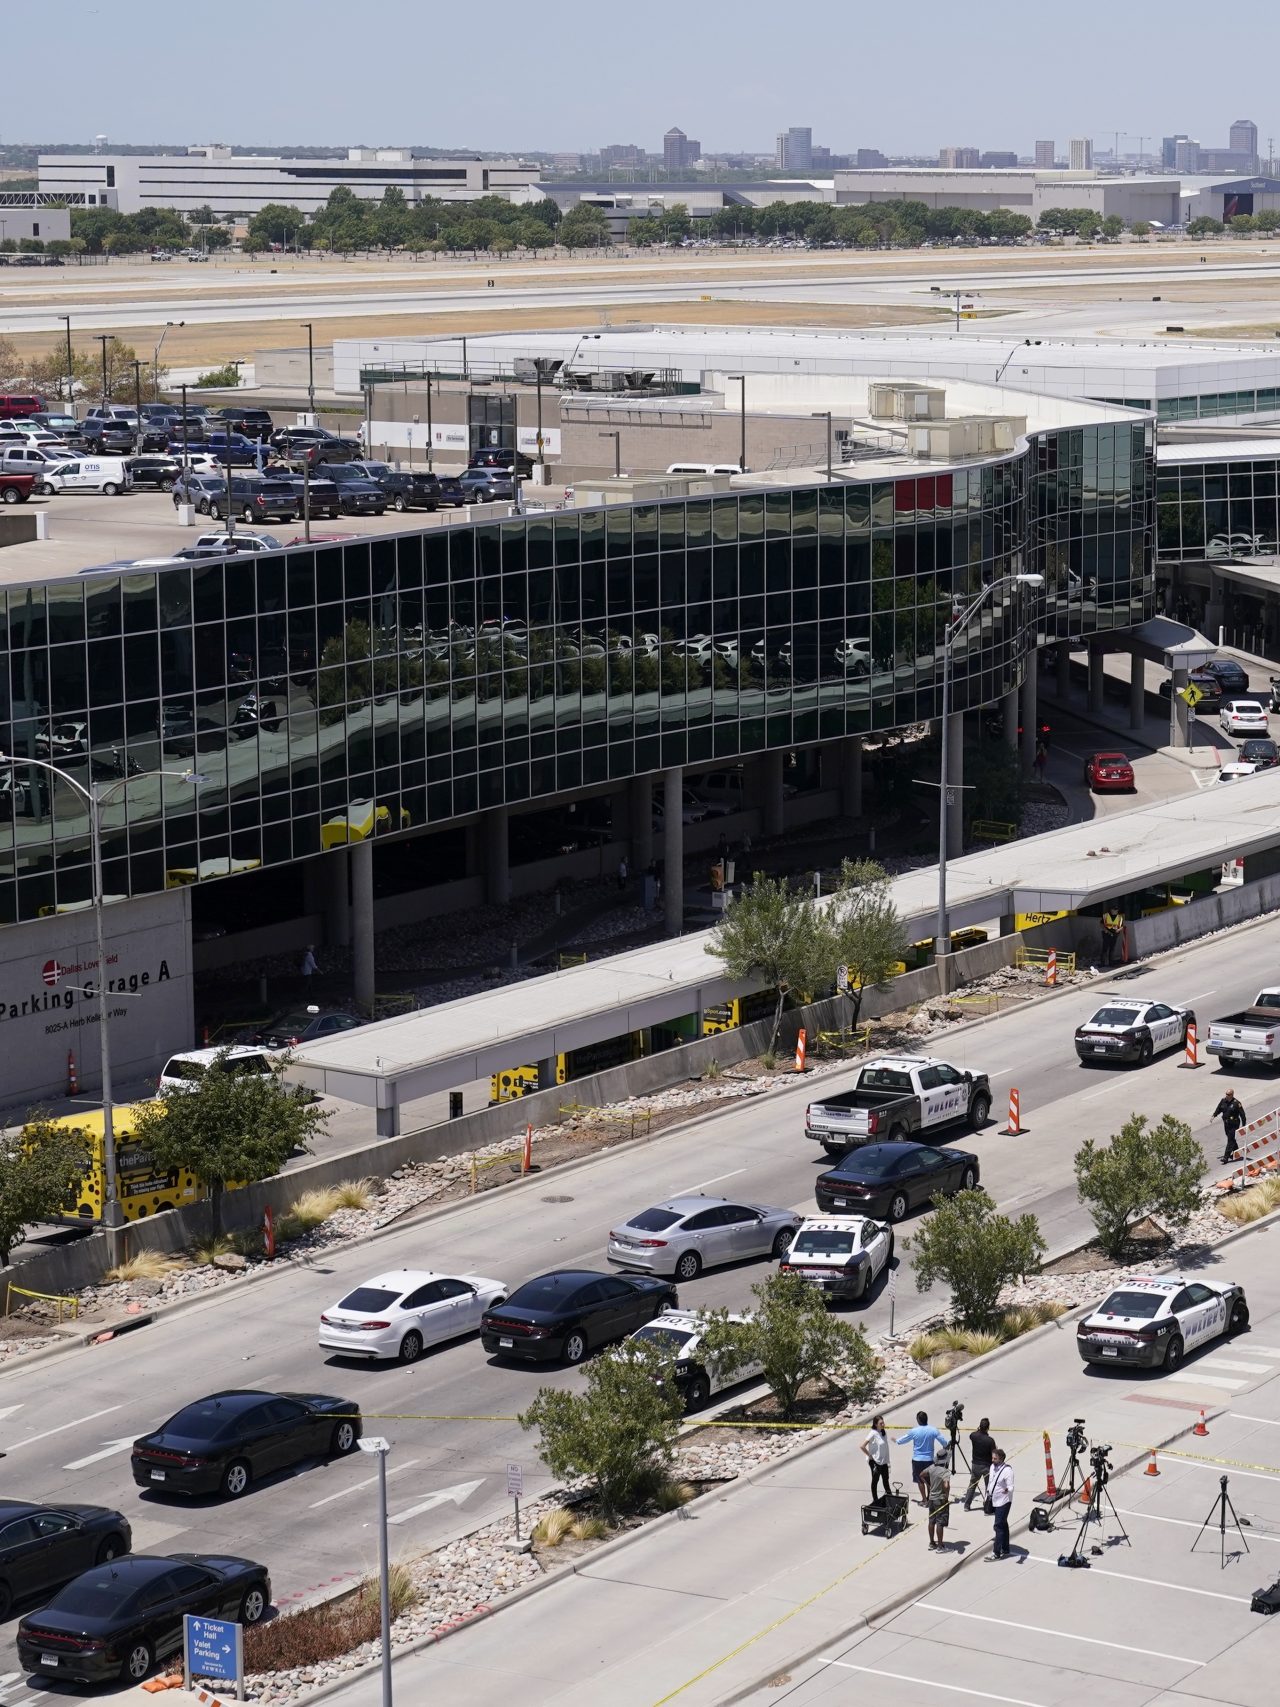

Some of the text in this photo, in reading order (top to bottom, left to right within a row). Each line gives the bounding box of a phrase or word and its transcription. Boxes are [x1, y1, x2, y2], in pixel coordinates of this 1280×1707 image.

[1025, 912, 1051, 925] Hertz
[61, 964, 83, 976] Dallas
[84, 960, 100, 971] Love
[0, 991, 74, 1018] Parking
[158, 959, 171, 982] A
[45, 1022, 69, 1035] 8025-A
[69, 1017, 85, 1029] Herb
[113, 1007, 128, 1018] Way
[927, 1100, 960, 1116] POLICE
[1126, 1281, 1173, 1292] 9096
[1184, 1309, 1218, 1339] POLICE
[203, 1622, 224, 1633] Ticket
[203, 1631, 217, 1640] Hall
[194, 1639, 211, 1649] Valet
[194, 1648, 220, 1660] Parking
[202, 1665, 226, 1674] SEWELL
